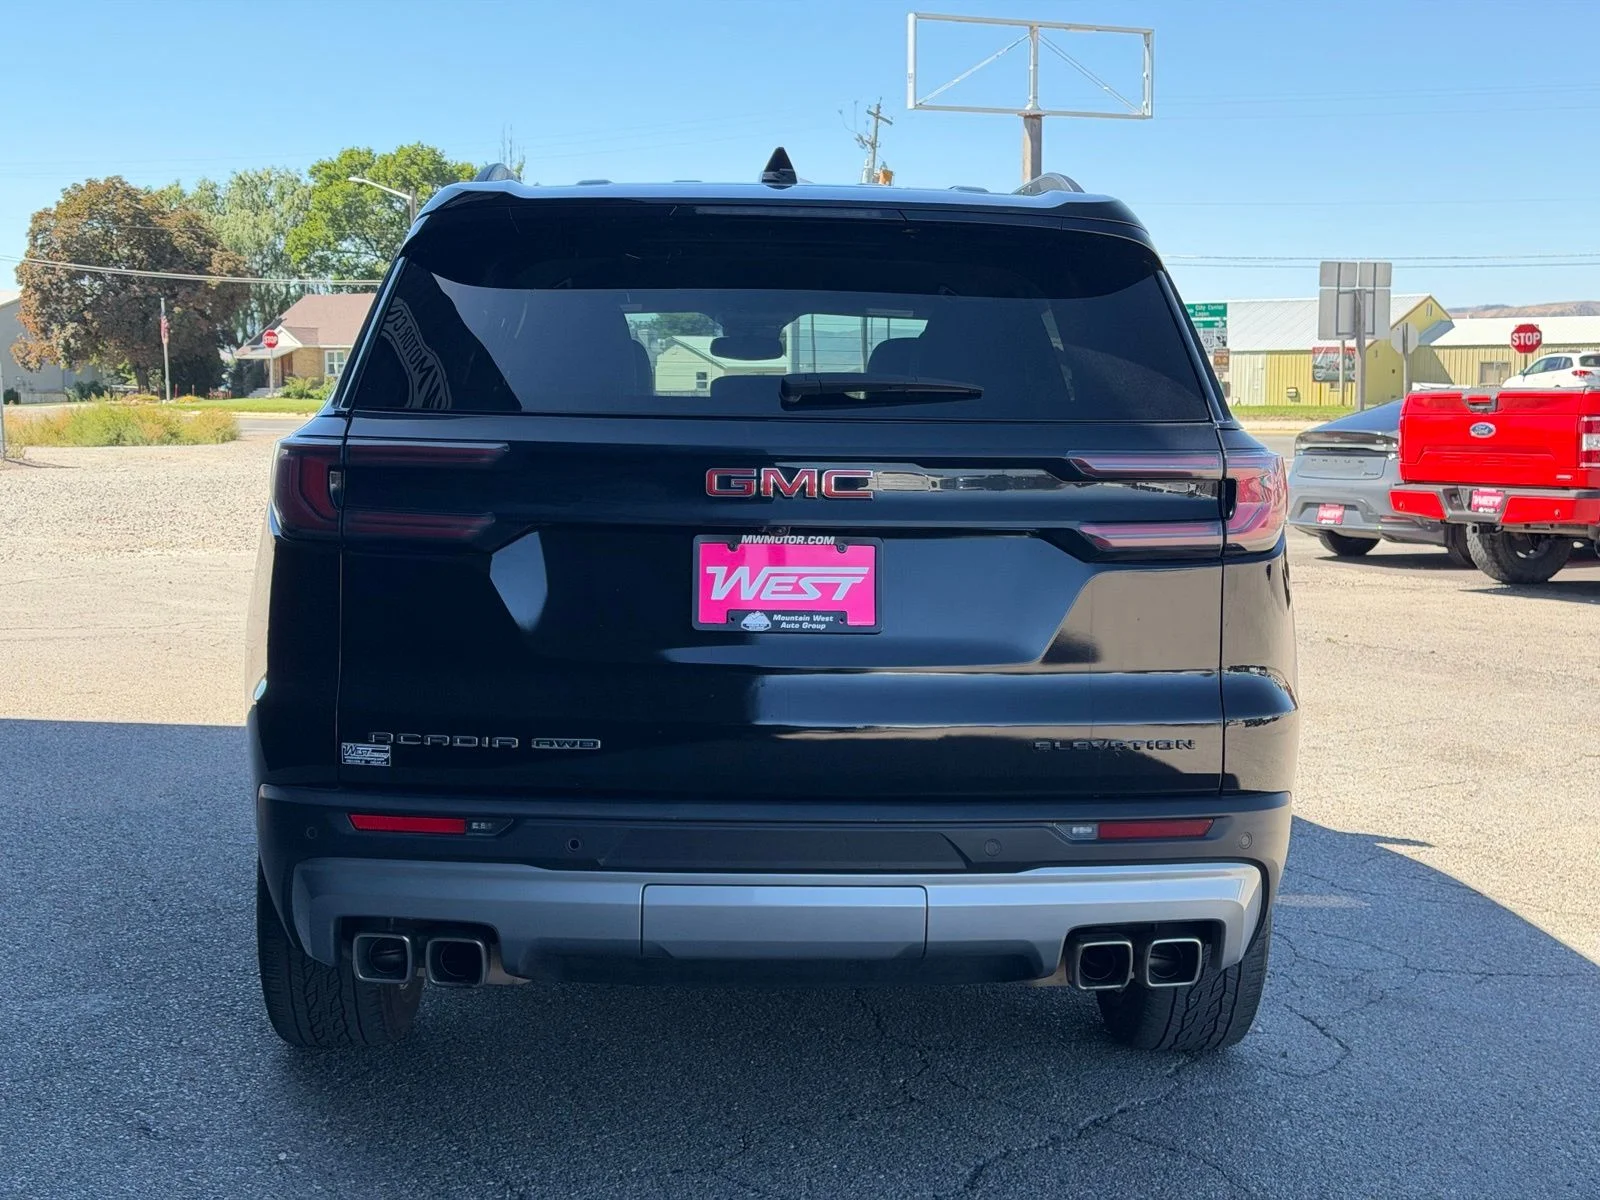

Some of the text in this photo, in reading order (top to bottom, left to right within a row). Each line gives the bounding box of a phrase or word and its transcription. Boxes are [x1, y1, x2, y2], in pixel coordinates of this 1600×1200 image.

[1512, 332, 1541, 346] STOP
[705, 467, 873, 499] GMC
[741, 534, 835, 545] MWMOTOR.COM
[772, 614, 811, 622] Mountain
[801, 622, 827, 631] Group
[368, 731, 601, 750] ACADIA AWD
[1034, 739, 1196, 750] ELEVATION
